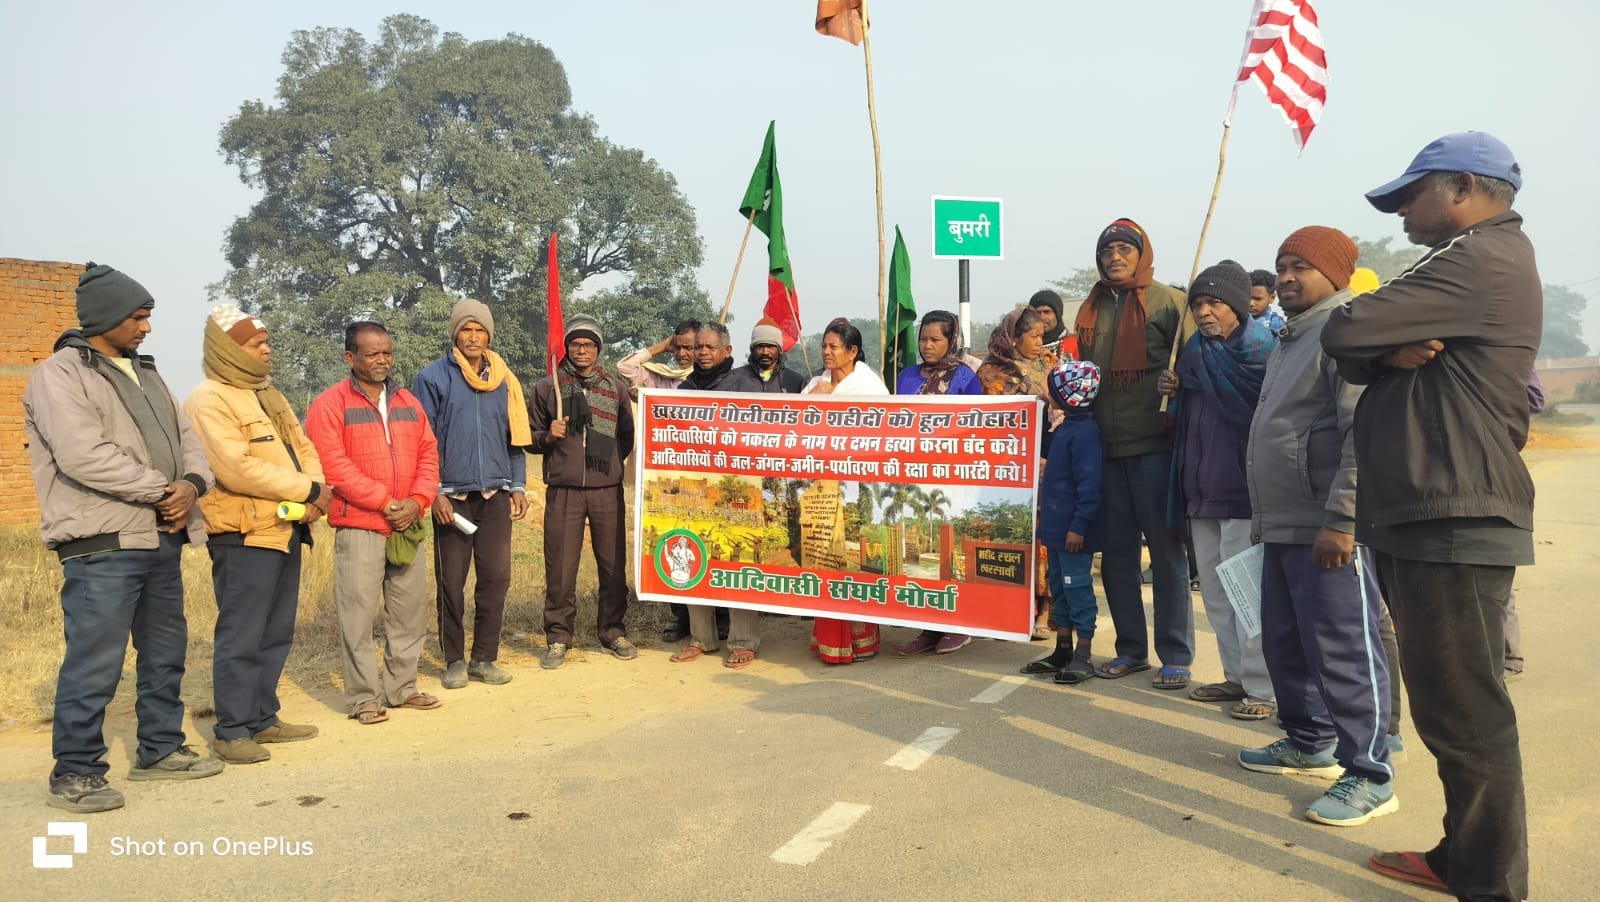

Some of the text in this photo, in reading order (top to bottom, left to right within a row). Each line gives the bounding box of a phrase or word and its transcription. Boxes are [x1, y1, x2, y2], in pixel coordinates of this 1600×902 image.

[947, 213, 991, 244] बुमरी
[720, 404, 800, 424] गोलीकांड
[804, 405, 822, 425] के
[827, 407, 886, 428] शहीदों
[888, 408, 916, 428] को
[919, 412, 955, 434] हूल
[652, 425, 719, 445] आदिवासियों
[721, 428, 738, 445] को
[785, 430, 799, 448] के
[802, 434, 828, 450] नाम
[831, 436, 848, 451] पर
[850, 436, 882, 452] दमन
[885, 436, 916, 453] हत्या
[920, 437, 959, 454] करना
[963, 434, 986, 455] बंद
[652, 448, 711, 467] आदिवासियों
[713, 451, 727, 468] की
[882, 458, 900, 477] की
[904, 462, 928, 478] रक्षा
[932, 463, 950, 479] का
[954, 460, 991, 480] गारंटी
[709, 567, 958, 612] आदिवासी संघर्ष मोर्चा
